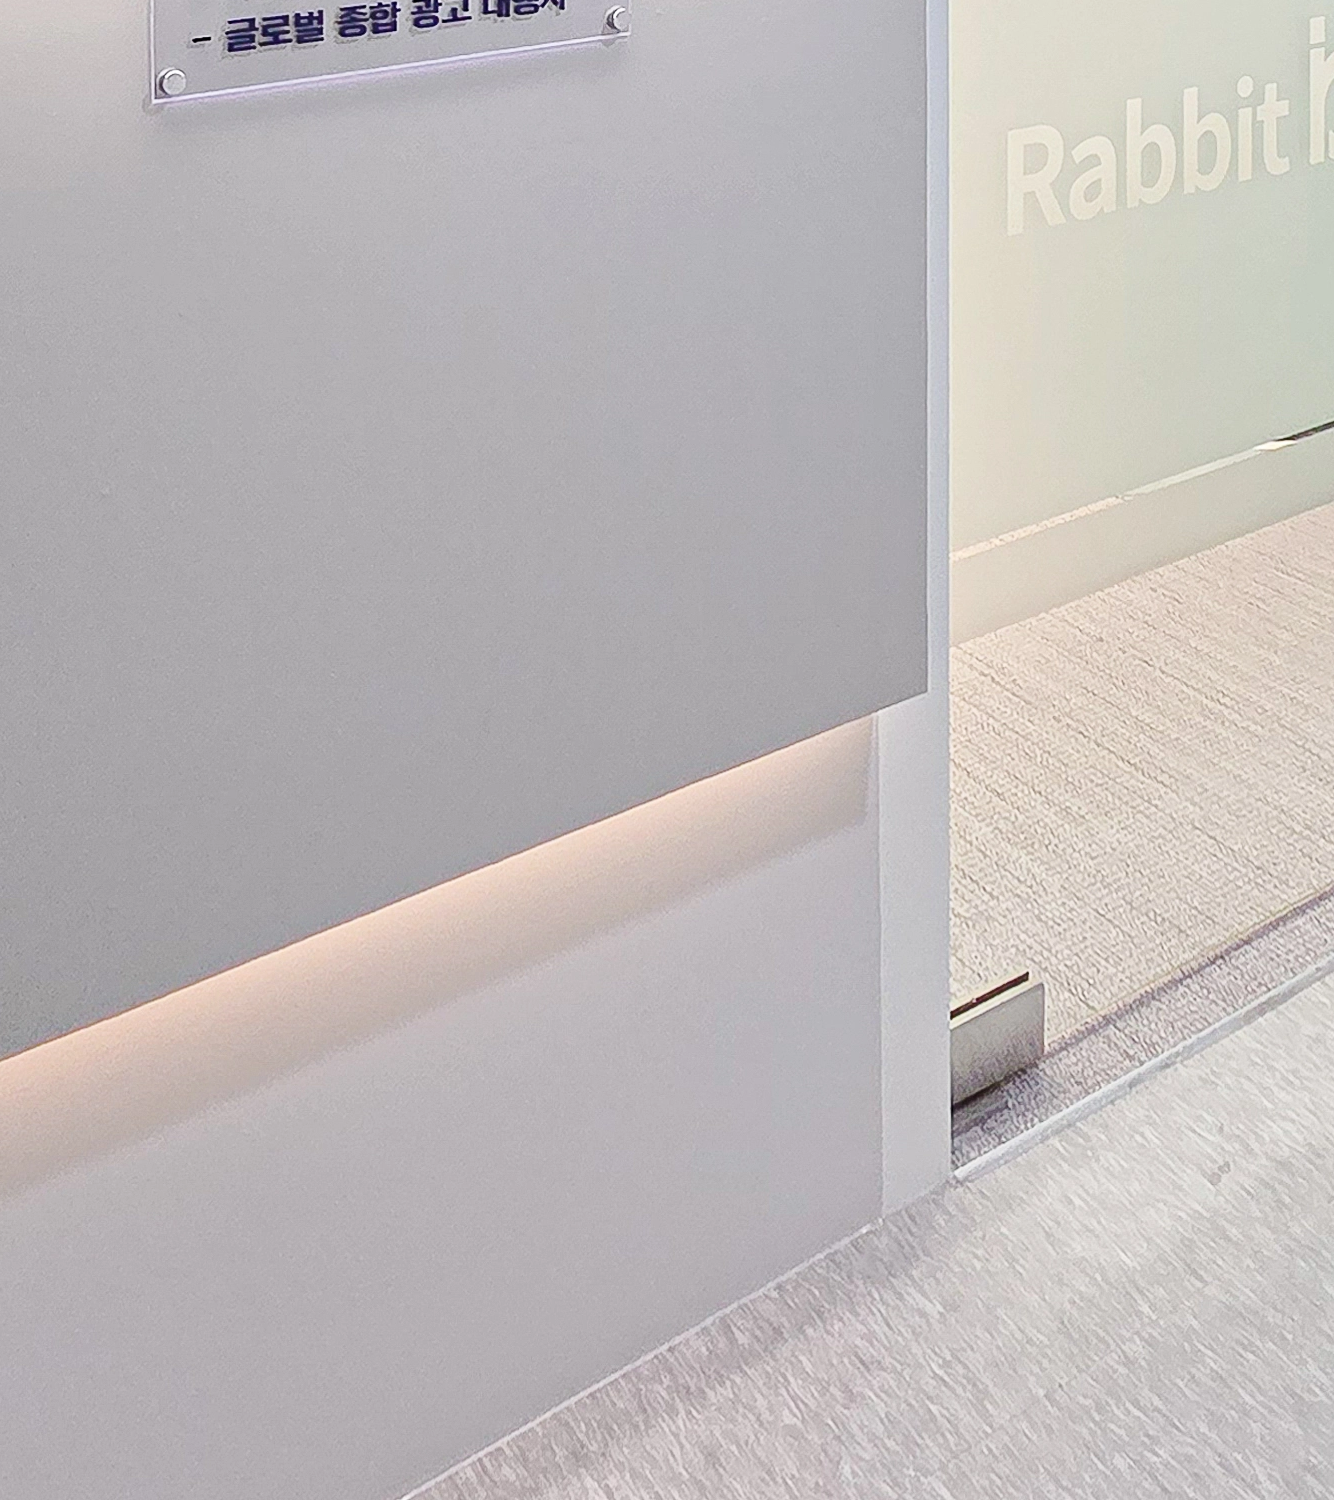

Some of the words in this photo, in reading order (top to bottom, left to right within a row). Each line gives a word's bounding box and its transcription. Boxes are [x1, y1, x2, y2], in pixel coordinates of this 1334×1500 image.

[224, 9, 325, 53] 글로벌
[335, 1, 402, 38] 종합
[1006, 74, 1291, 237] Rabbit
